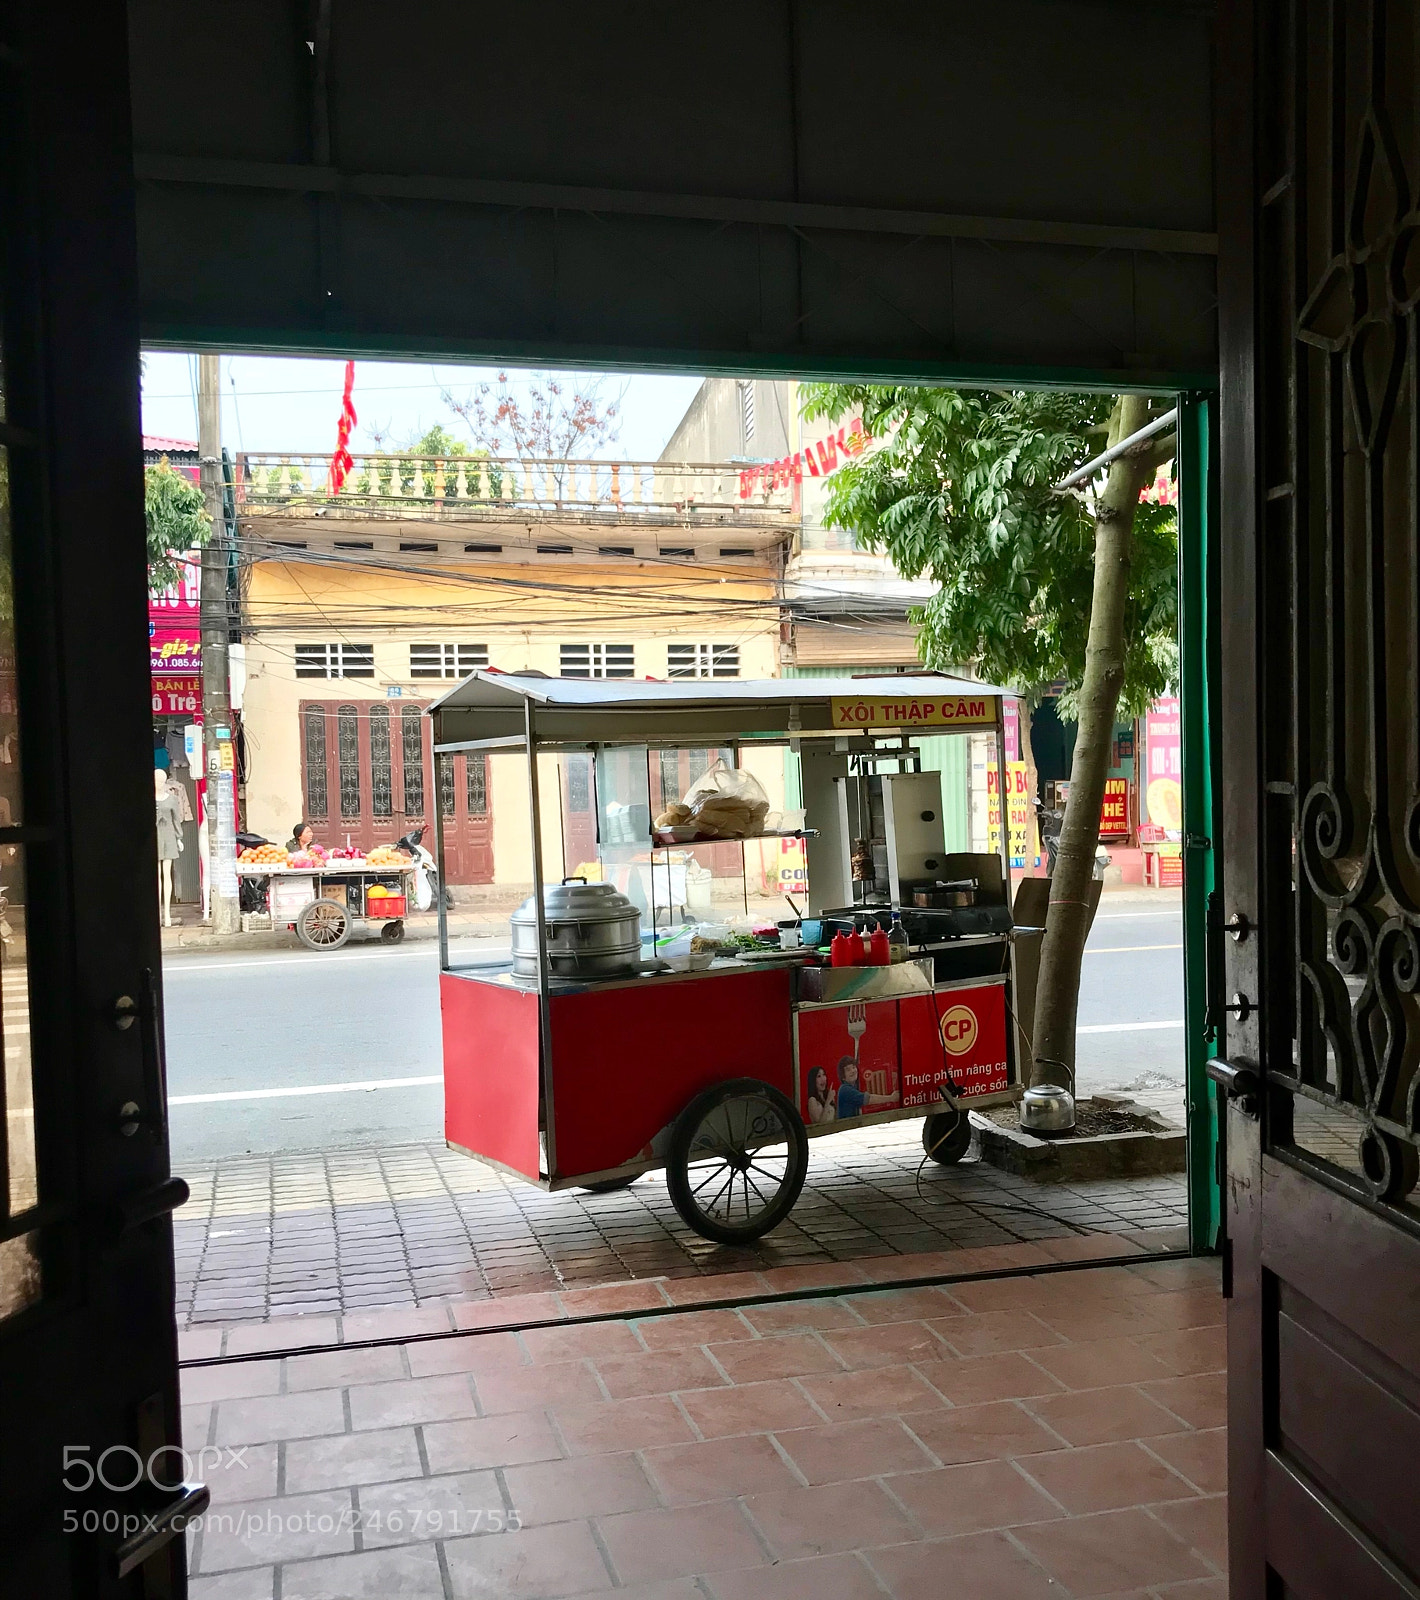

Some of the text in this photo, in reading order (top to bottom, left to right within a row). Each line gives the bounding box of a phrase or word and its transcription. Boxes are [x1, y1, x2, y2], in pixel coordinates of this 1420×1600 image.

[156, 679, 184, 691] BÁN
[167, 692, 197, 712] Trẻ
[839, 701, 875, 722] XÔI
[881, 700, 935, 725] THẬP
[944, 1019, 972, 1042] CP
[903, 1090, 927, 1106] chất
